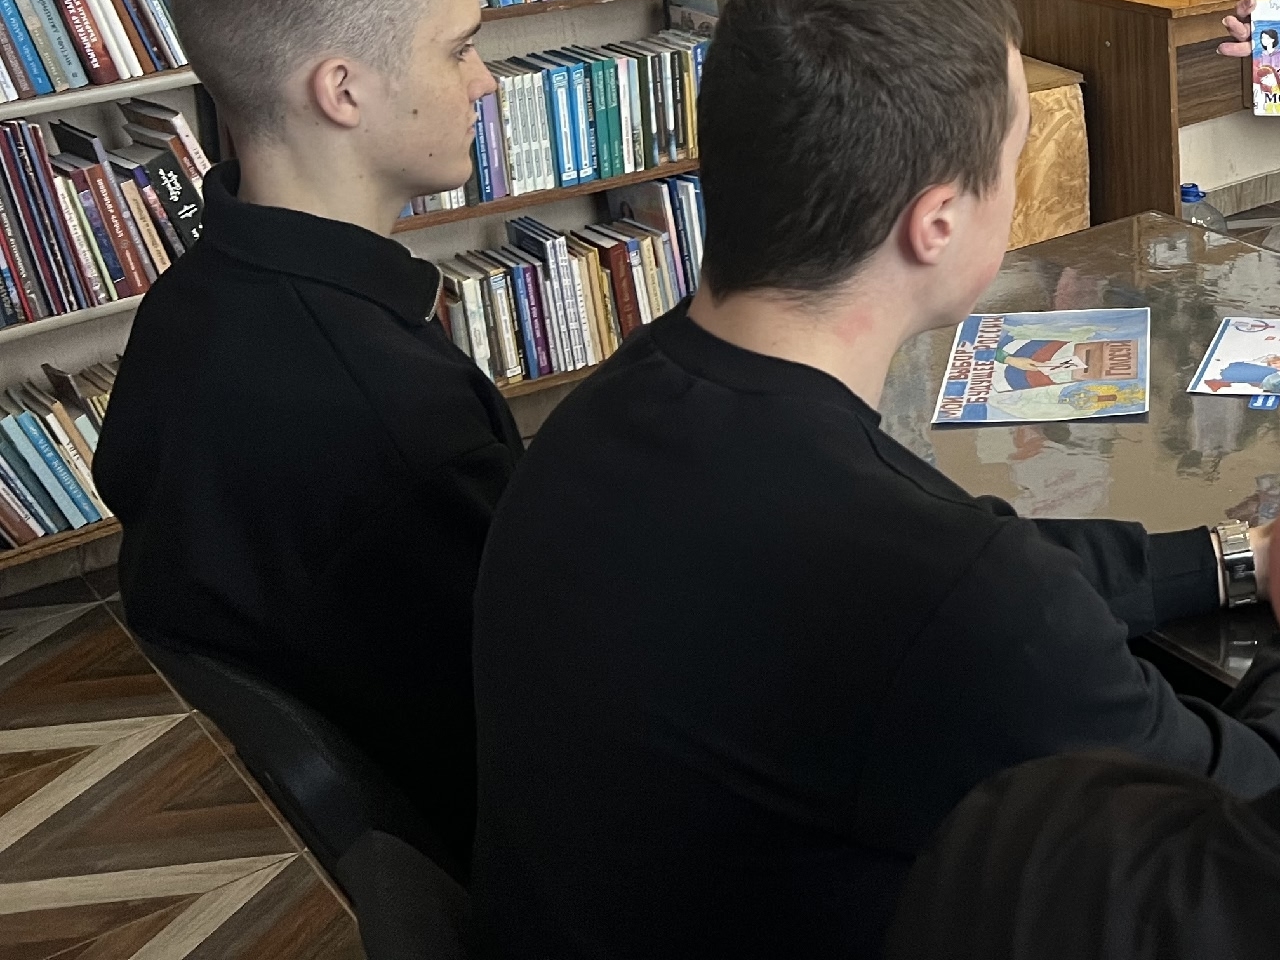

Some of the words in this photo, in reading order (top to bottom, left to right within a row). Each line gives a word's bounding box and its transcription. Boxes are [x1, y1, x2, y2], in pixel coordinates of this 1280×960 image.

[976, 316, 1005, 352] РОССИИ
[948, 345, 975, 382] ВЫБОР
[965, 358, 995, 405] БУДУЩЕЕ
[938, 395, 964, 420] МОЙ
